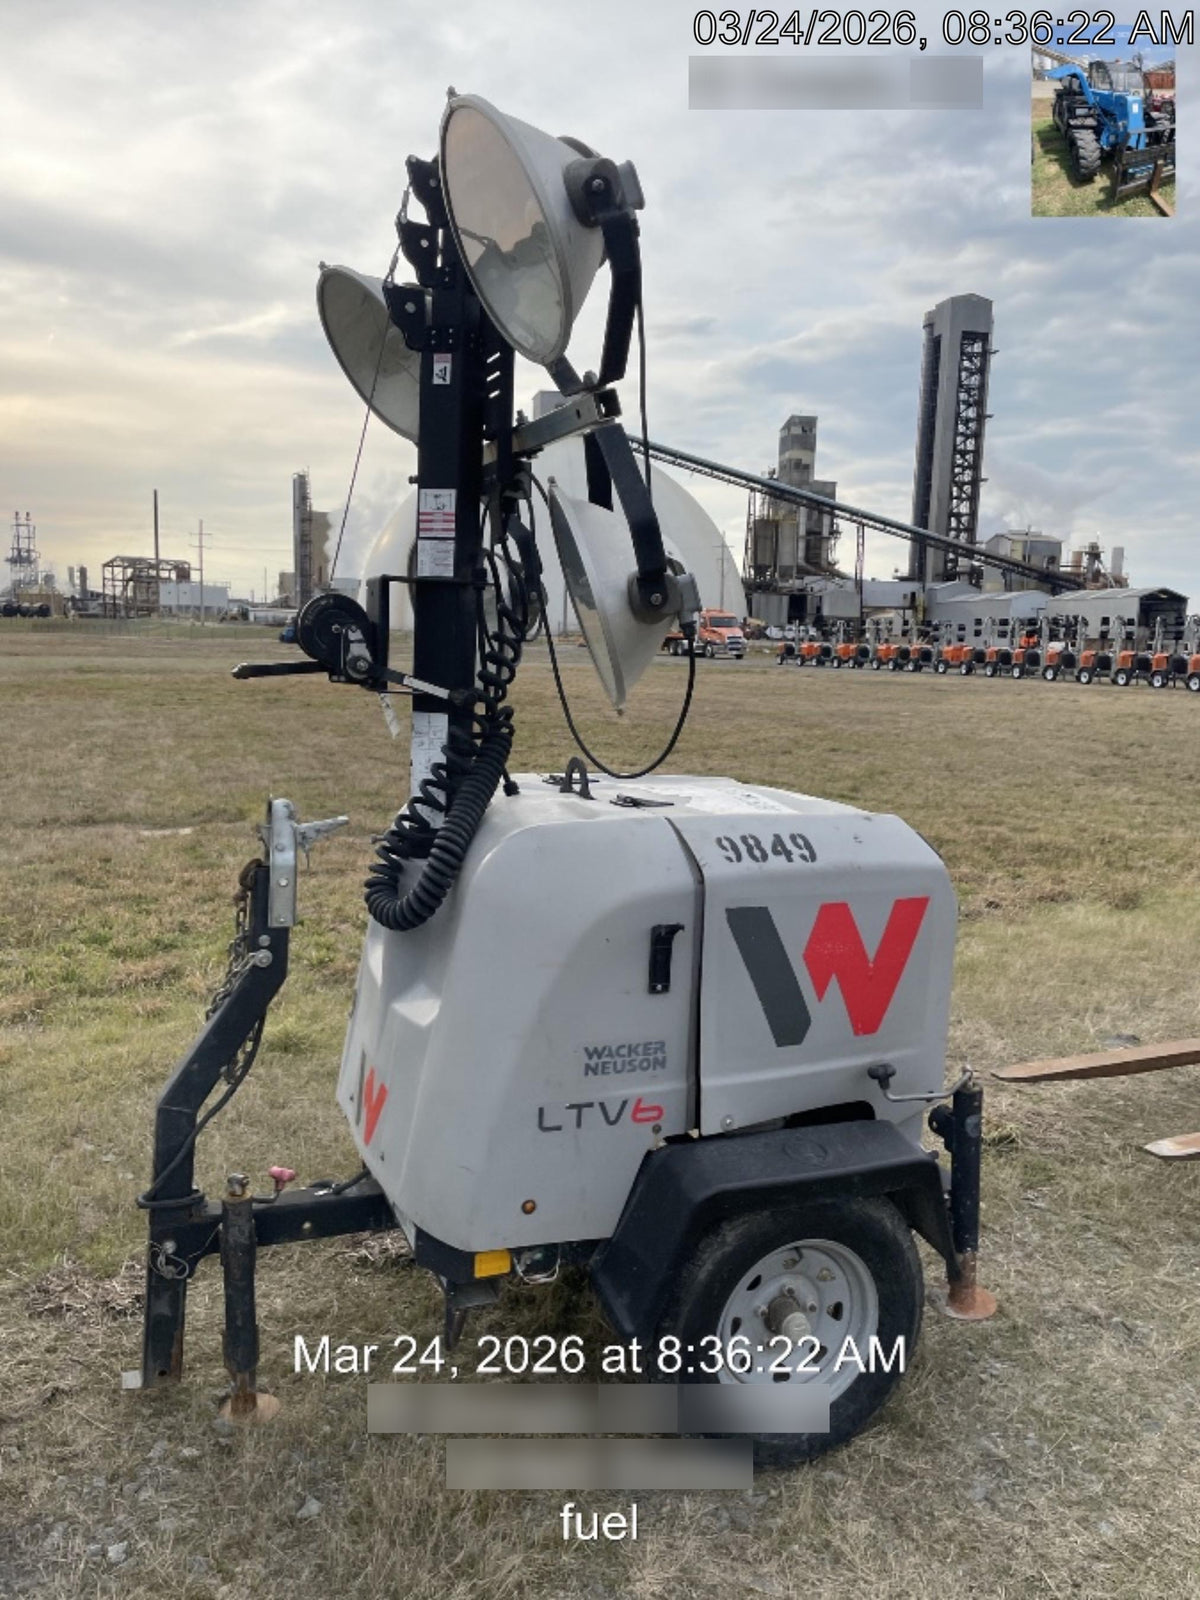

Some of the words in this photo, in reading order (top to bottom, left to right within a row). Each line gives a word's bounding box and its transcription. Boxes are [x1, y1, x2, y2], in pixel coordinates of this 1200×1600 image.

[715, 833, 818, 863] 9849
[583, 1041, 666, 1060] WACKER
[583, 1056, 667, 1077] NEUSON
[537, 1097, 665, 1133] LTV6
